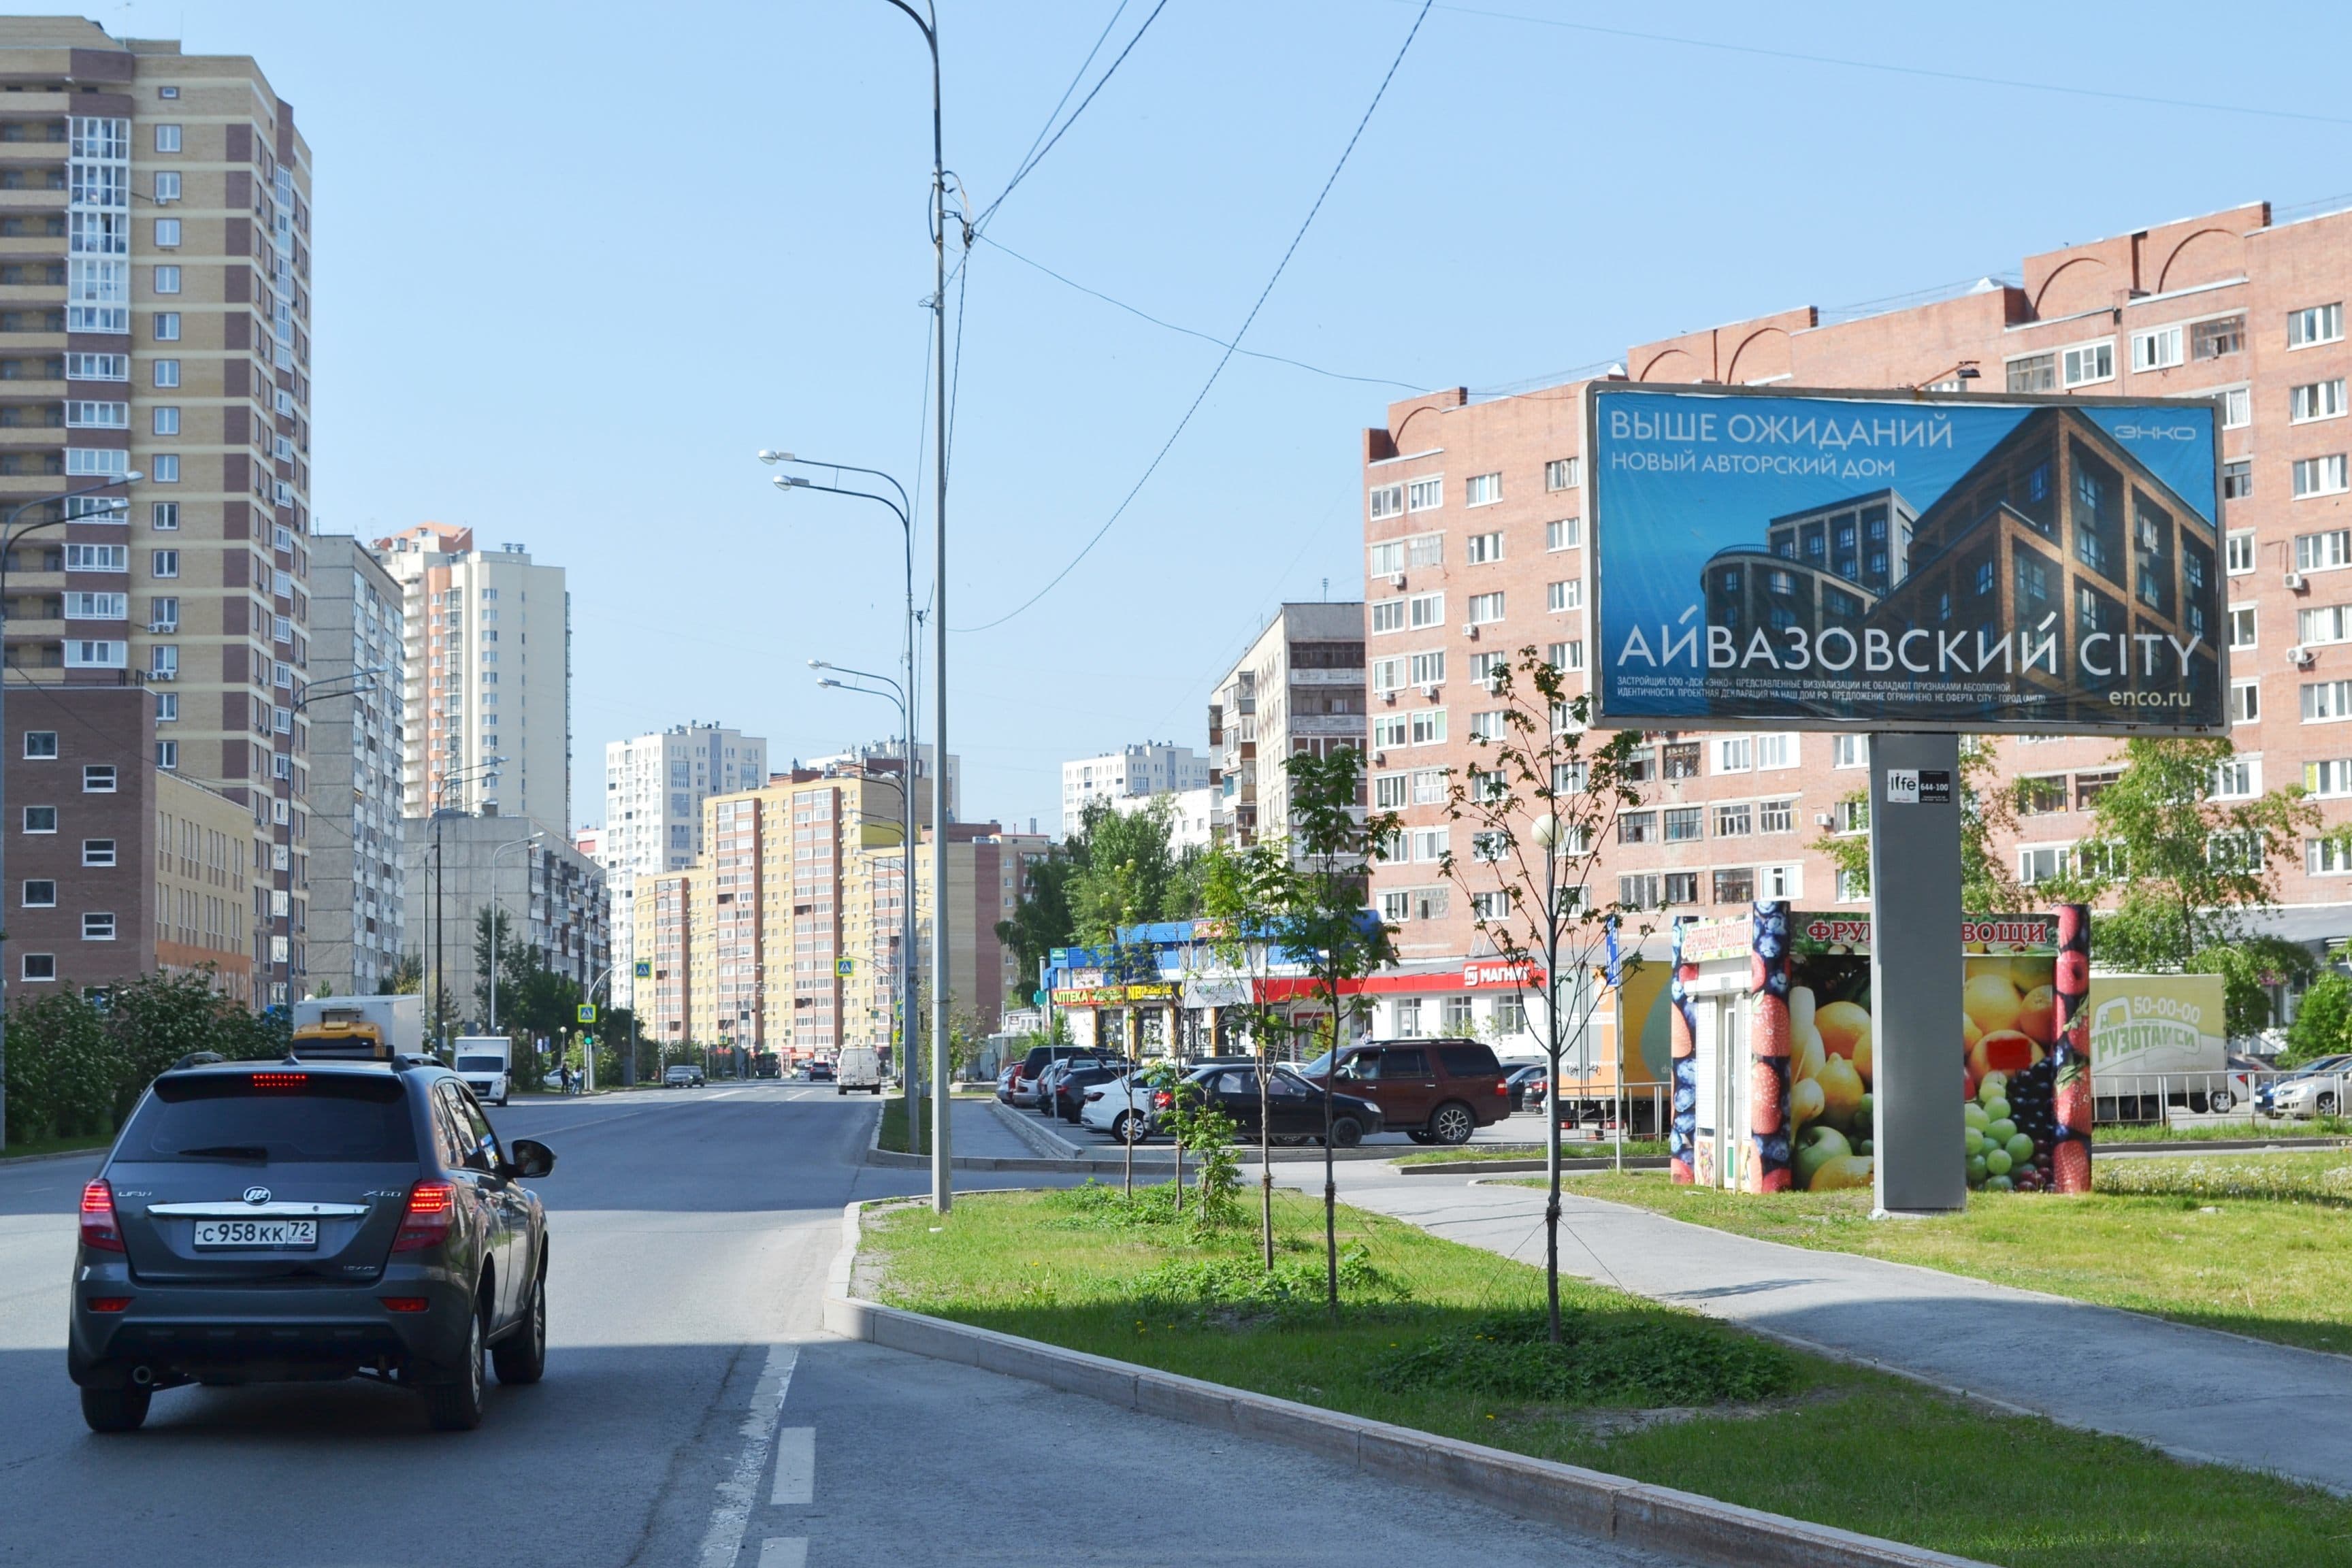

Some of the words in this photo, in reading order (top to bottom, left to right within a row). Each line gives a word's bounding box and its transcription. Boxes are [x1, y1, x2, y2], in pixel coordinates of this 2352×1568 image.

[1611, 410, 1717, 442] ВЫШЕ
[1727, 412, 1953, 451] ОЖИДАНИЙ
[1612, 449, 1695, 472] НОВЫЙ
[1701, 453, 1837, 476] АВТОРСКИЙ
[1842, 458, 1895, 479] ДОМ
[1616, 604, 2057, 674] АЙВАЗОВСКИЙ
[2079, 632, 2202, 676] CITY
[1617, 675, 1667, 686] ЗАСТРОЙЩИК
[1668, 677, 1683, 686] ООО
[1735, 679, 1801, 689] ПРЕДСТАВЛЕННЫЕ
[1803, 680, 1861, 690] ВИЗУАЛИЗАЦИИ
[1862, 681, 1871, 689] НЕ
[1873, 681, 1911, 691] ОБЛАДАЮТ
[1913, 682, 1961, 691] ПРИЗНАКАМИ
[1963, 681, 2010, 692] АБСОЛЮТНОЙ
[1678, 688, 1720, 698] ПРОЕКТНАЯ
[1720, 689, 1768, 699] ДЕКЛАРАЦИЯ
[1832, 691, 1885, 701] ПРЕДЛОЖЕНИЕ
[1935, 693, 1945, 702] НЕ
[1999, 693, 2022, 704] ГОРОД
[2109, 691, 2191, 706] enco.ru
[1920, 783, 1949, 791] 644-100
[1808, 920, 1870, 943] ФРУ
[1962, 922, 2047, 947] ВОЩИ
[1054, 990, 1088, 1003] АПТЕКА
[2134, 996, 2200, 1024] 50-00-00
[290, 1222, 310, 1237] 72
